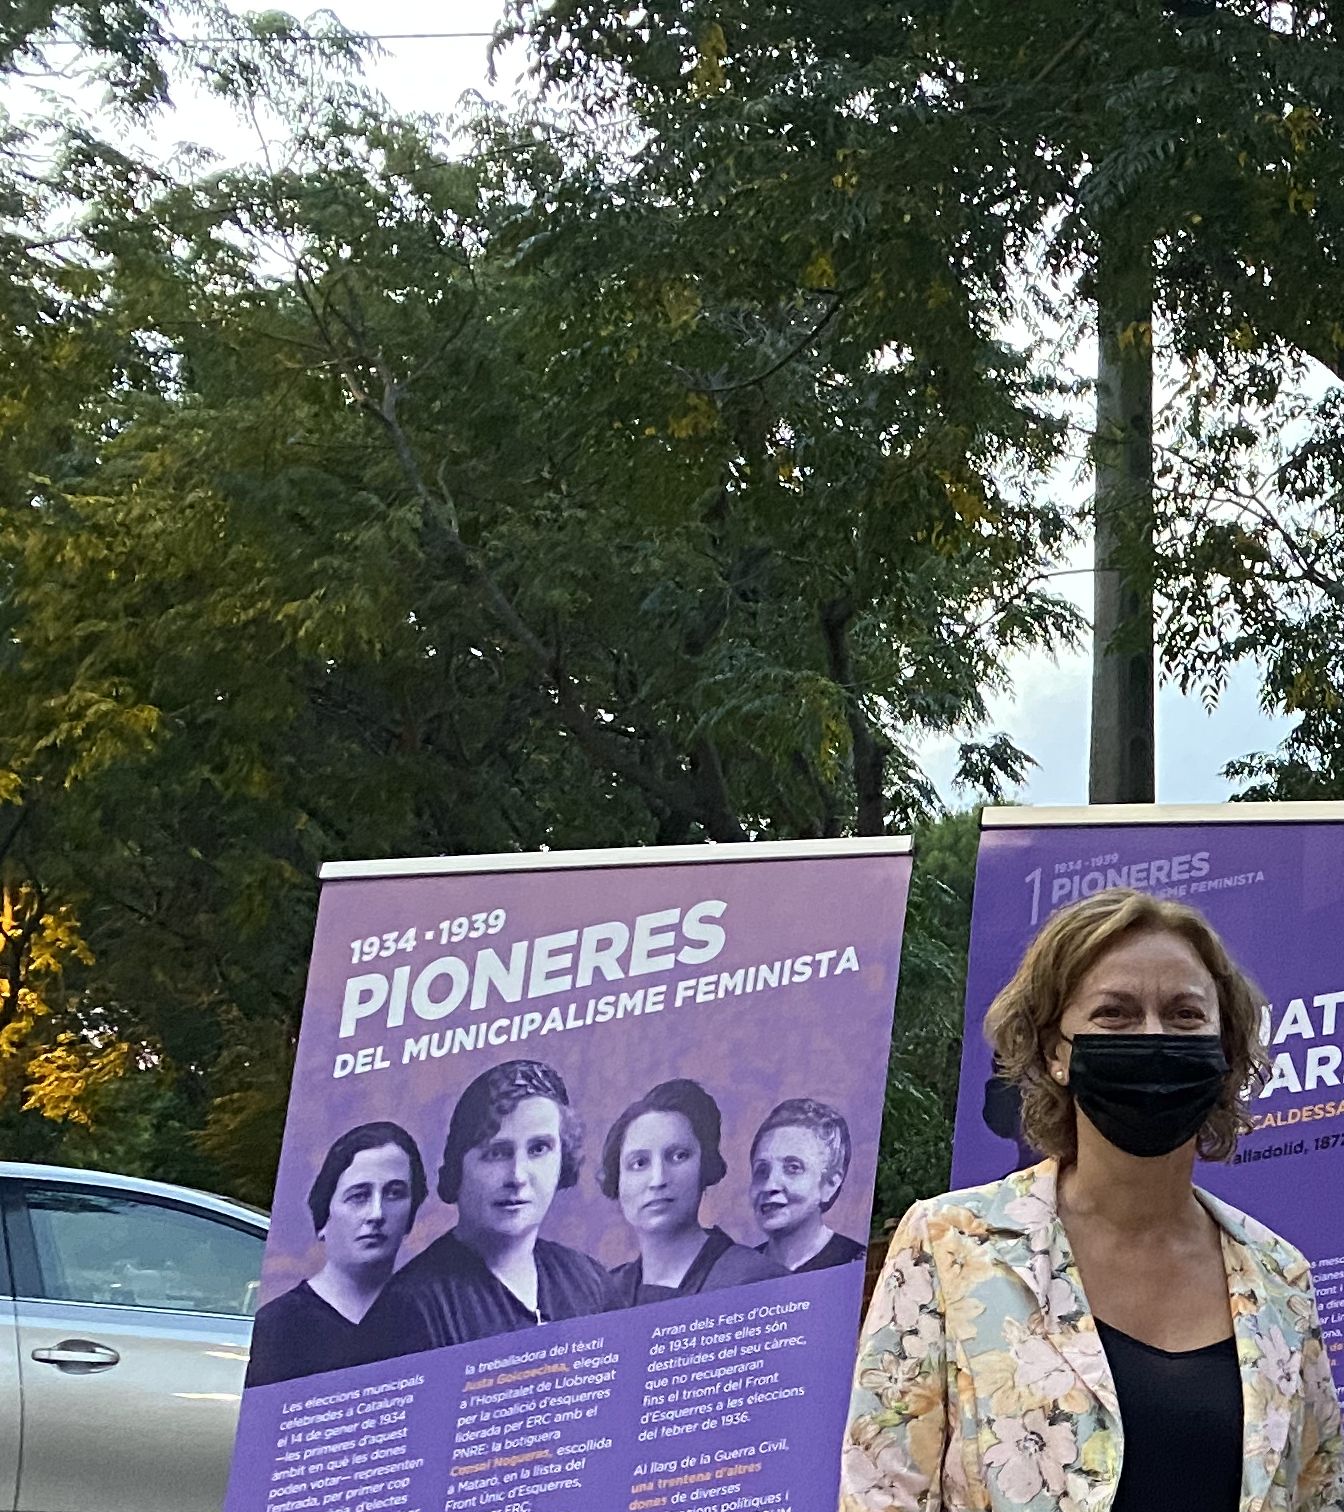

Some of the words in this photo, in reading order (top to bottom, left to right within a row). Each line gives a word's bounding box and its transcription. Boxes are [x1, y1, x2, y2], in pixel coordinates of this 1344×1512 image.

[1051, 852, 1210, 904] PIONERES
[1055, 860, 1082, 874] 1934
[1091, 853, 1119, 867] 1939
[1190, 871, 1264, 893] FEMINISTA
[350, 927, 418, 964] 1934
[439, 909, 507, 944] 1939
[338, 900, 729, 1038] PIONERES
[333, 1045, 391, 1079] DEL
[401, 986, 665, 1064] MUNICIPALISME
[674, 946, 861, 1008] FEMINISTA
[1231, 1140, 1308, 1165] alladolid,
[651, 1324, 685, 1338] Arran
[689, 1317, 714, 1330] dels
[718, 1313, 744, 1324] Fets
